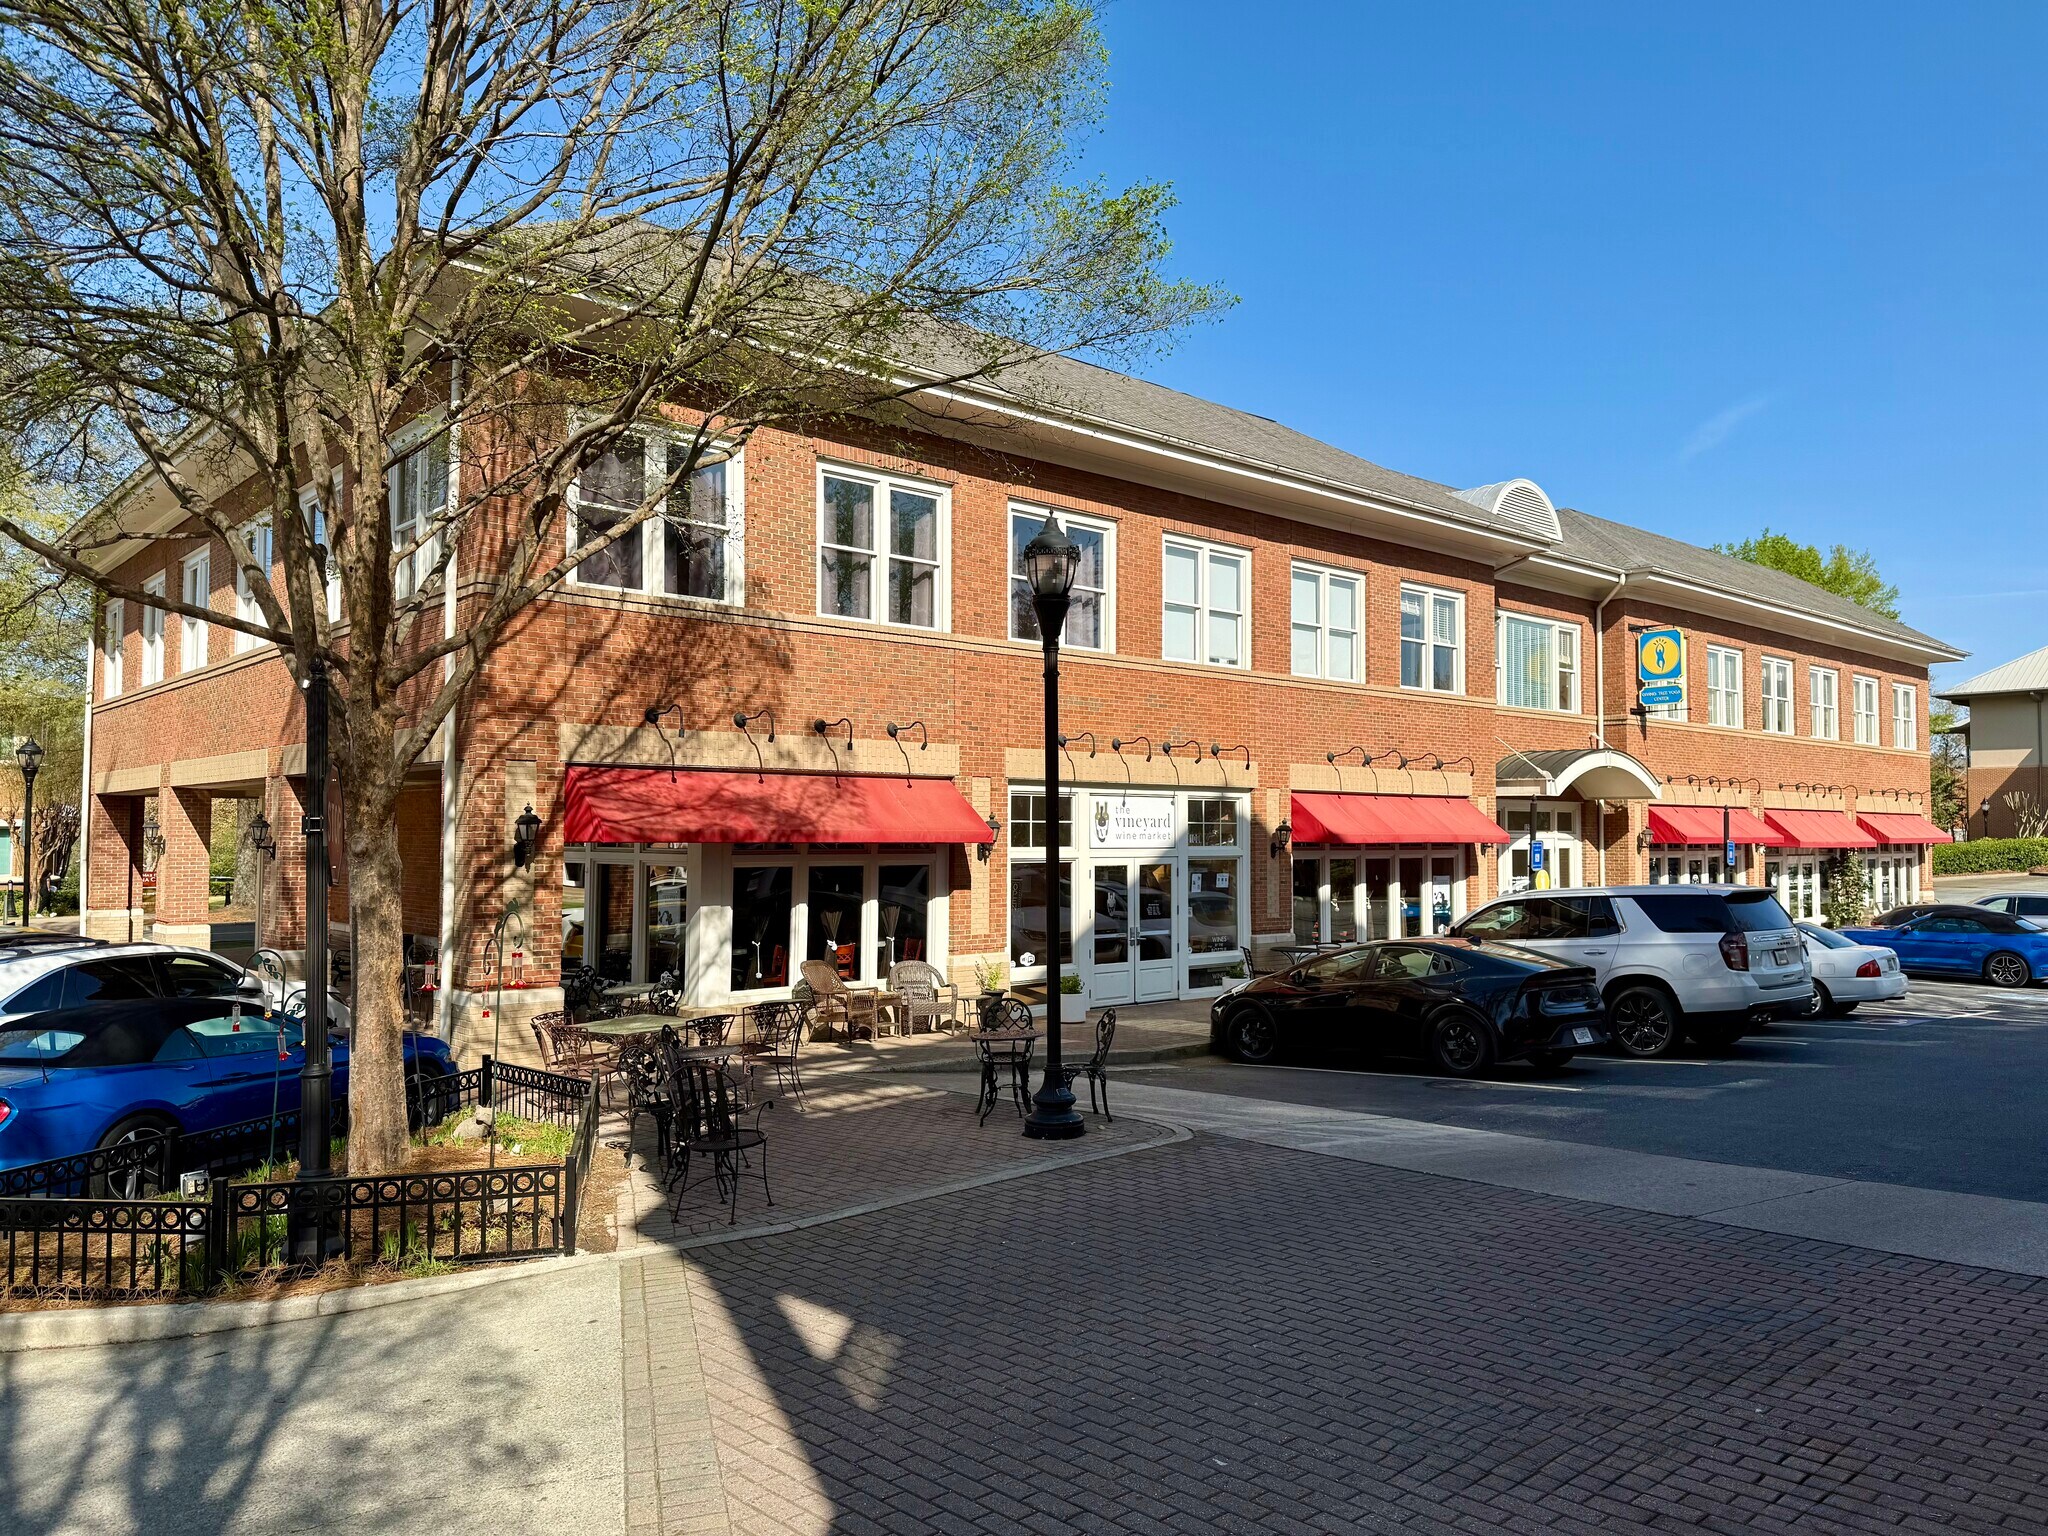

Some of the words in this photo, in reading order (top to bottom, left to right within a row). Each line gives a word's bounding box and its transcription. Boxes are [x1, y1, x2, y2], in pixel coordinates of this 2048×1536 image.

[1115, 806, 1131, 814] the
[1115, 813, 1171, 831] vineyard
[1116, 831, 1137, 840] wine
[1139, 831, 1171, 840] market
